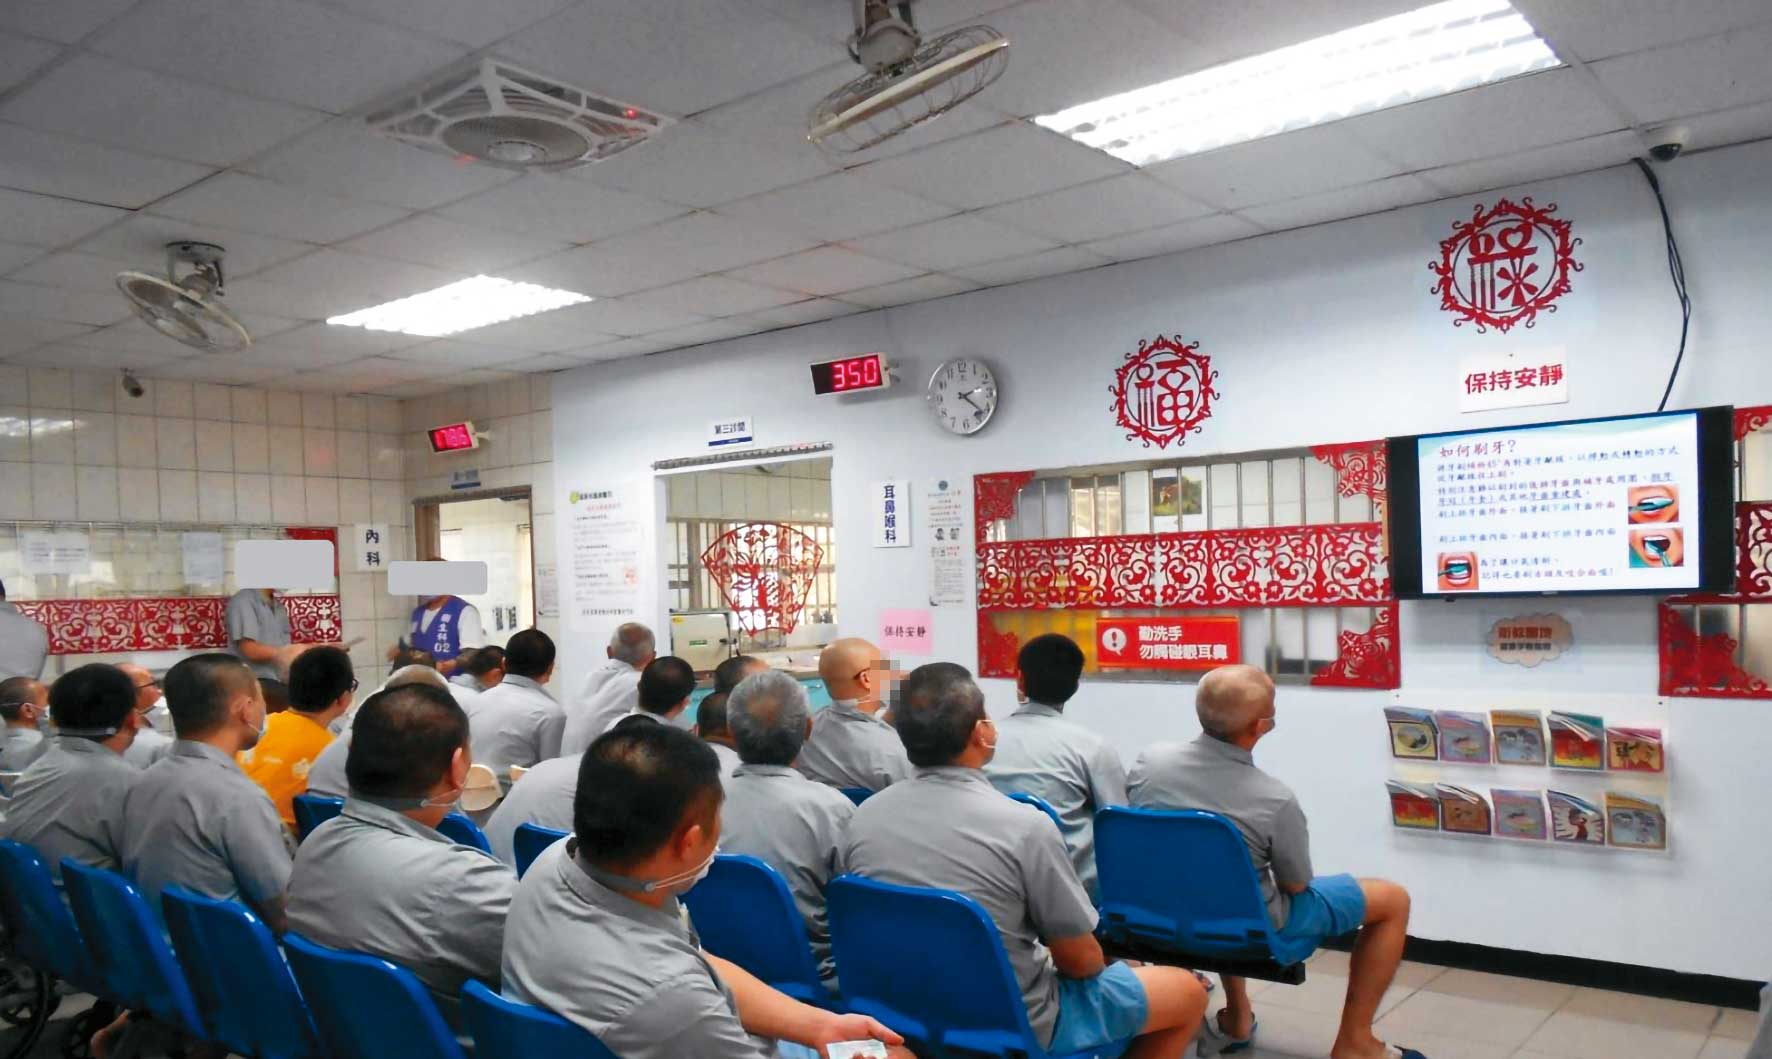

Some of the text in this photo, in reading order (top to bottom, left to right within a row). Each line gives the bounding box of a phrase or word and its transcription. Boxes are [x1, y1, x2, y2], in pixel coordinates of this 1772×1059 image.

[832, 359, 878, 389] 350
[1465, 364, 1563, 394] 保持安靜
[884, 485, 896, 543] 耳鼻喉科
[1138, 625, 1182, 641] 勤洗手
